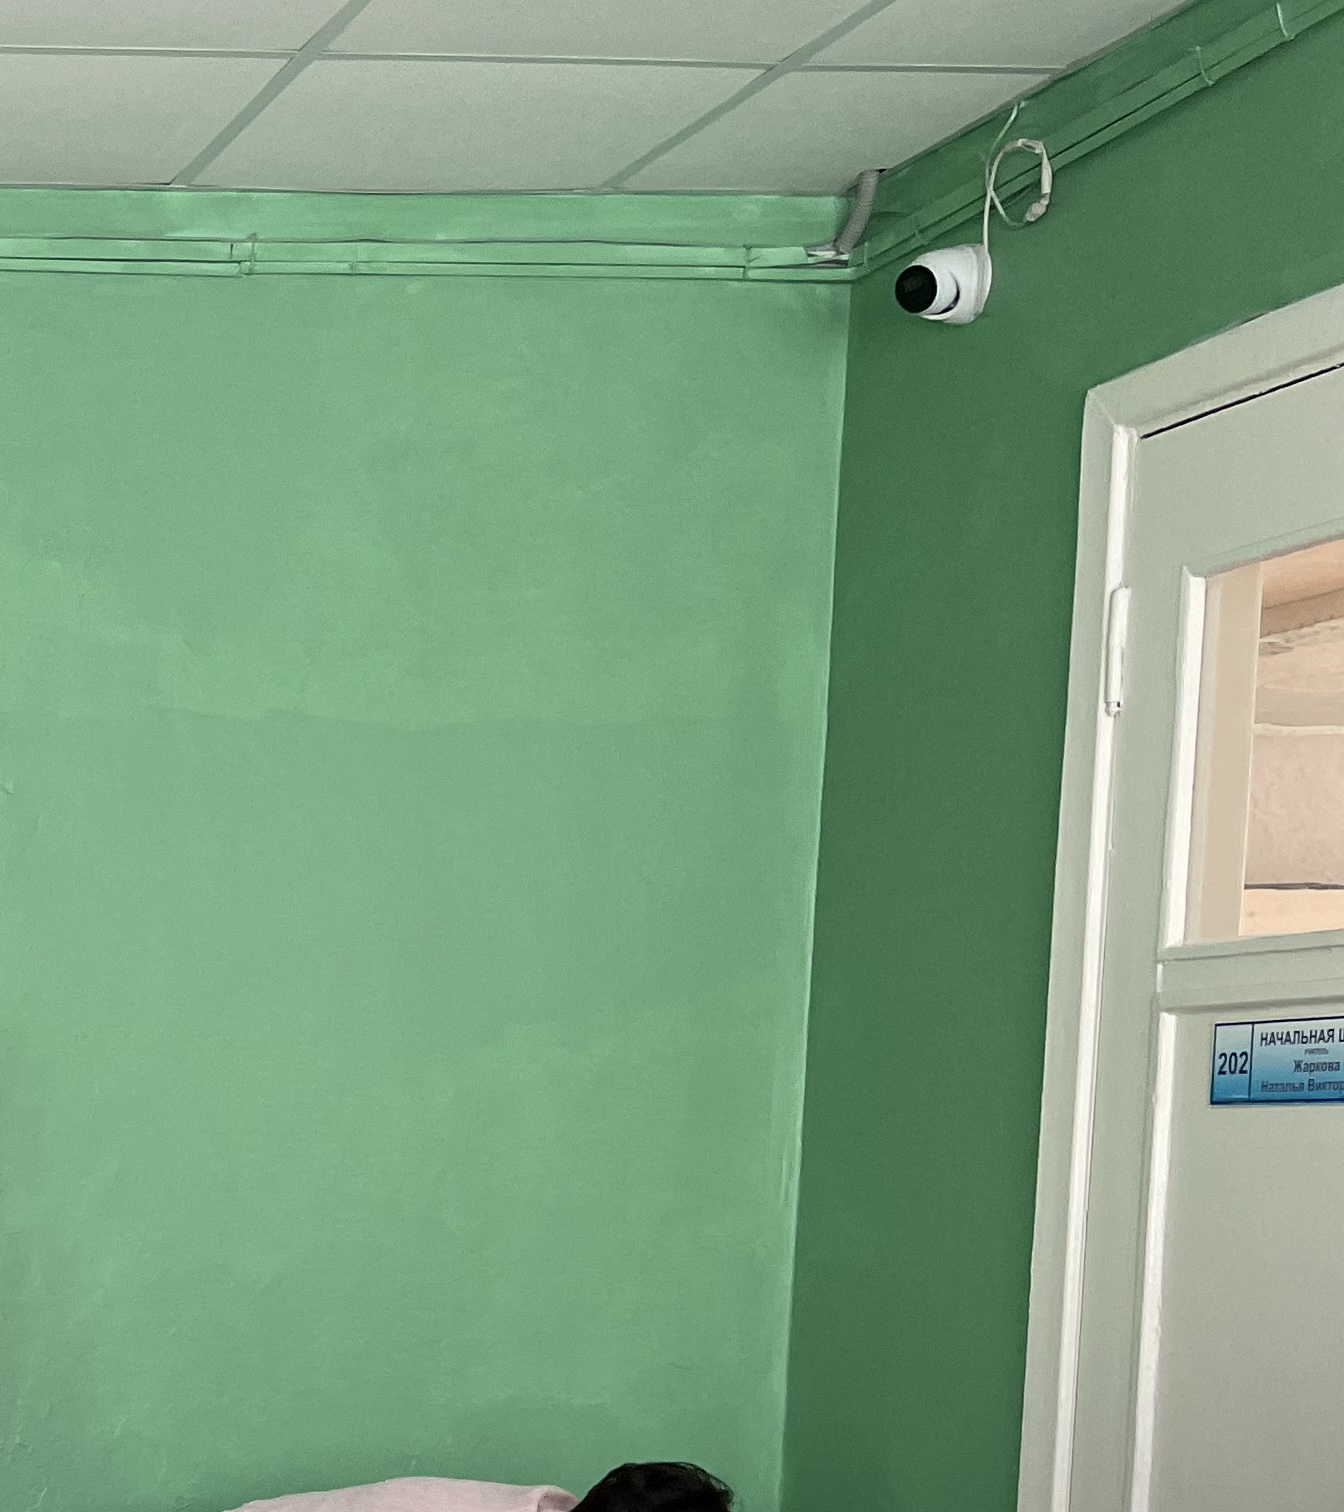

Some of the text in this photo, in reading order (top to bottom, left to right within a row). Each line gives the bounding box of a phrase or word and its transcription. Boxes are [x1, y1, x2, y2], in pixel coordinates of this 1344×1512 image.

[1259, 1028, 1335, 1047] НАЧАЛЬНАЯ
[1217, 1051, 1249, 1076] 202
[1293, 1060, 1341, 1076] Жаркова
[1308, 1078, 1344, 1095] Виктор
